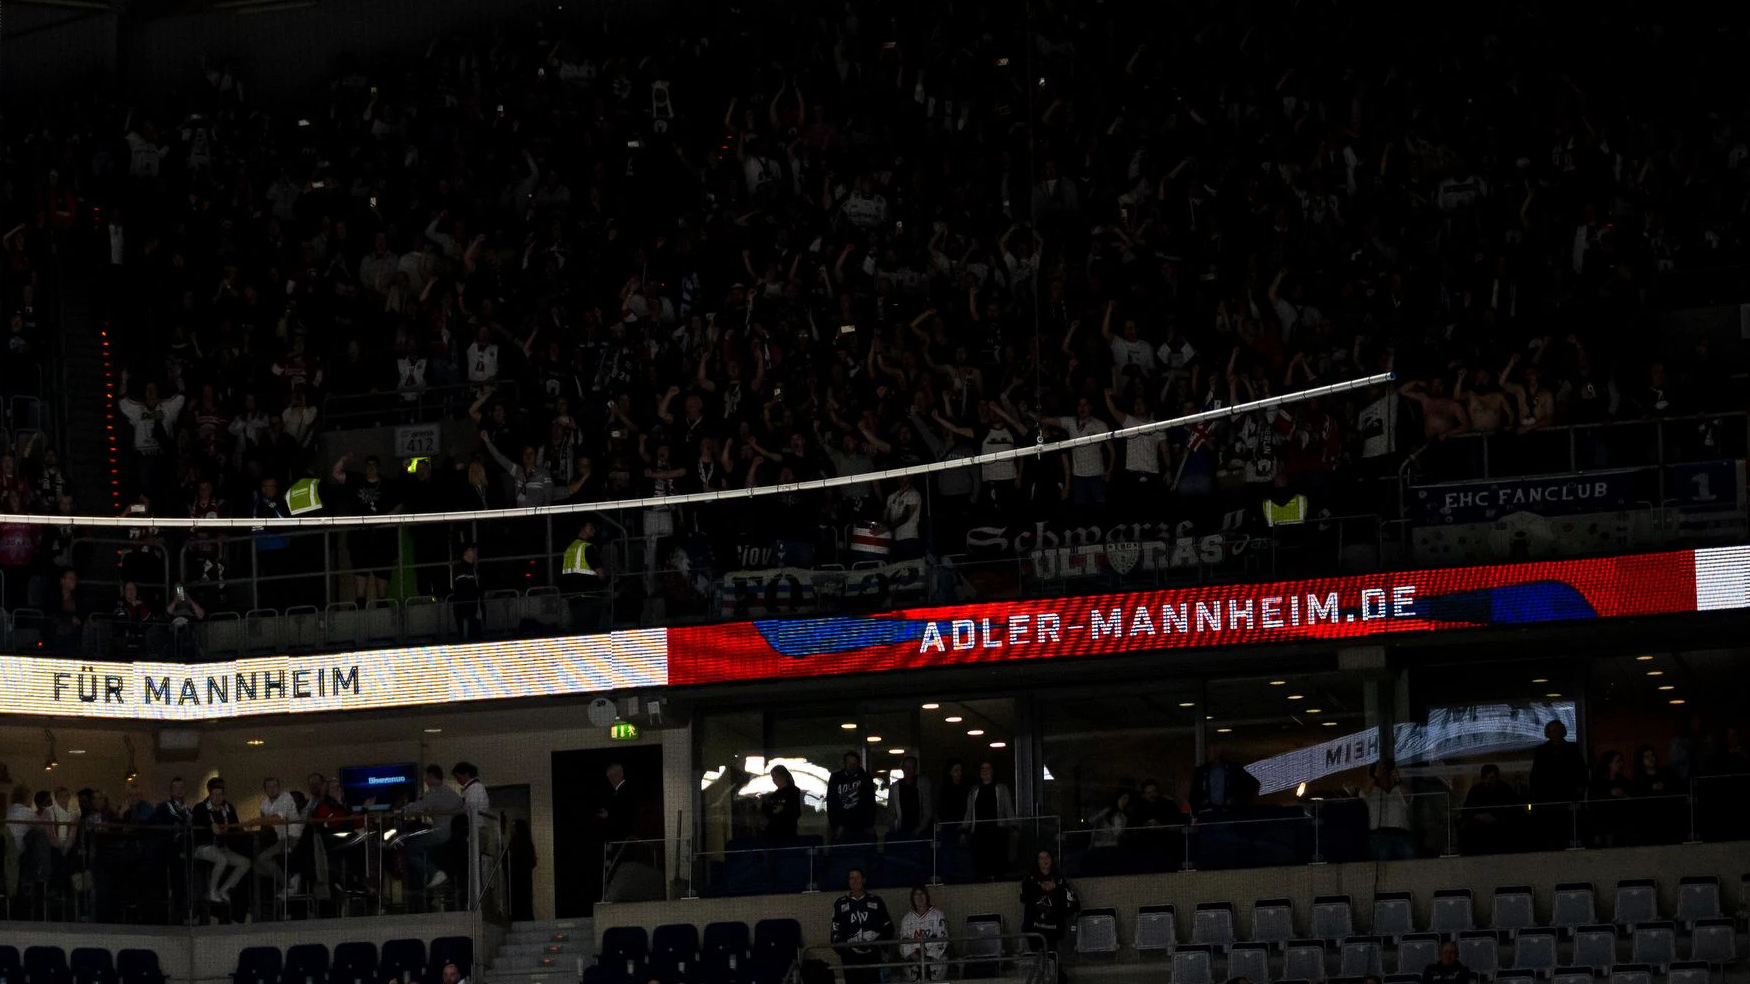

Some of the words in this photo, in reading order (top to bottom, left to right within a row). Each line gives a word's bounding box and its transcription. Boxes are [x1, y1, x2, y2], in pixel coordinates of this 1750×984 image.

[407, 438, 433, 451] 412
[1445, 492, 1489, 509] EHC
[1498, 482, 1608, 505] FANCLUB
[920, 586, 1417, 653] ADLER-MANNHEIM.DE
[54, 666, 124, 704] FÜR
[145, 666, 360, 705] MANNHEIM
